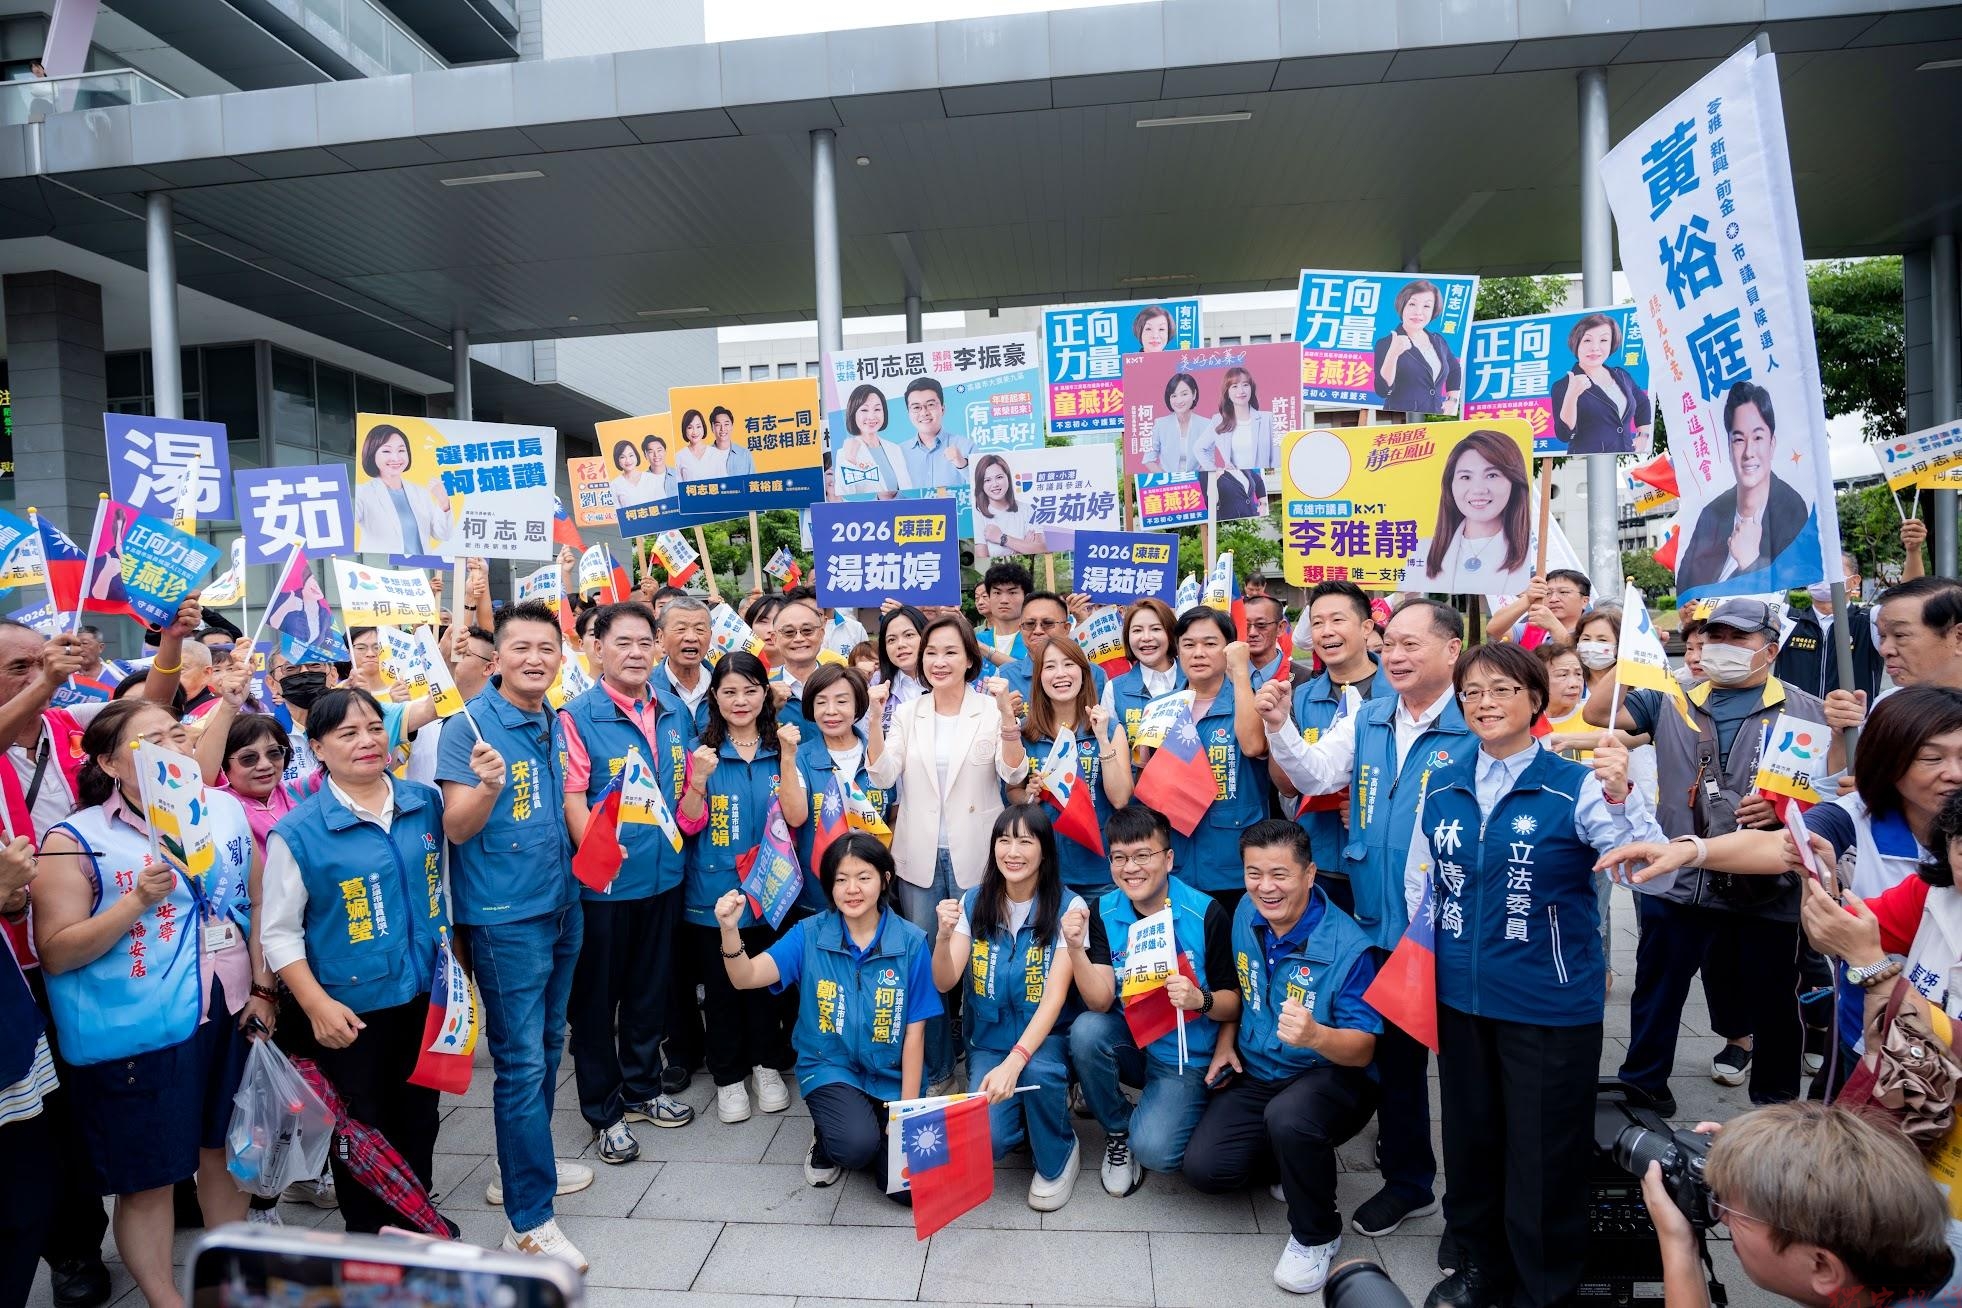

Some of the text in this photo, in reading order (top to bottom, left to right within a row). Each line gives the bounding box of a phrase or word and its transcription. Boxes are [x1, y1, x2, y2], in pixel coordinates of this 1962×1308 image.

[1710, 137, 1729, 177] 新興
[1715, 179, 1736, 218] 前金
[1641, 117, 1753, 402] 黃裕庭
[1306, 278, 1381, 314] 正向
[1440, 283, 1466, 335] 有志一童
[1732, 243, 1779, 374] 市議員候選人
[1053, 310, 1118, 346] 正向
[1303, 313, 1376, 350] 力量
[1473, 322, 1551, 363] 正向
[835, 360, 855, 371] 市長
[857, 351, 928, 381] 柯志恩
[932, 350, 952, 362] 議員
[933, 361, 953, 373] 力挺
[953, 342, 1026, 371] 李振豪
[1055, 345, 1121, 382] 力量
[836, 370, 856, 382] 支持
[1303, 358, 1372, 387] 童燕珍
[1471, 359, 1550, 401] 力量
[969, 405, 990, 426] 有
[1054, 389, 1124, 417] 童燕珍
[744, 410, 812, 433] 有志一同
[971, 422, 1036, 446] 你真好!
[1056, 419, 1088, 429] 不忘初心
[1138, 404, 1154, 453] 柯志恩
[747, 429, 818, 452] 與您相庭!
[1373, 427, 1428, 446] 幸福宜居
[1681, 391, 1713, 482] 庭進議會
[435, 437, 543, 466] 選新市長
[1365, 441, 1435, 472] 靜在鳳山
[123, 429, 221, 513] 湯
[441, 462, 548, 496] 柯雄讚
[685, 483, 719, 496] 柯志恩
[749, 480, 783, 493] 黃裕庭
[1036, 480, 1093, 492] 市議員參選人
[625, 505, 660, 521] 柯志恩
[1028, 491, 1116, 525] 湯茹婷
[1144, 488, 1202, 515] 童燕珍
[1292, 503, 1349, 516] 高雄市議員
[1354, 503, 1387, 514] KMT
[250, 477, 346, 557] 茹
[463, 518, 547, 542] 柯志恩
[831, 521, 891, 543] 2026
[1289, 520, 1418, 559] 李雅靜
[127, 525, 208, 574] 正向力量
[1088, 544, 1131, 560] 2026
[1407, 558, 1425, 567] 博士
[3, 563, 45, 580] 志恩
[121, 553, 188, 602] 童燕珍
[826, 552, 941, 592] 湯茹婷
[1081, 566, 1164, 596] 湯茹婷
[1303, 565, 1406, 584] 懇請 唯一支持
[17, 608, 46, 624] 2026
[373, 600, 434, 618] 柯志恩
[1089, 614, 1115, 632] 夢想海港
[1091, 624, 1118, 639] 世界雄心
[1208, 745, 1229, 801] 柯志恩
[1792, 770, 1810, 790] 柯
[511, 760, 531, 821] 宋立彬
[711, 794, 730, 847] 陳玫娟
[732, 803, 740, 840] 高雄市議員
[862, 811, 876, 826] 柯
[1433, 818, 1467, 939] 林倩綺
[1503, 840, 1535, 942] 立法委員
[155, 903, 177, 942] 安寧
[1136, 922, 1166, 941] 夢想海港
[129, 921, 147, 978] 福安居
[1134, 937, 1167, 954] 世界雄心
[1025, 946, 1043, 1003] 柯志恩
[872, 987, 895, 1043] 柯志恩
